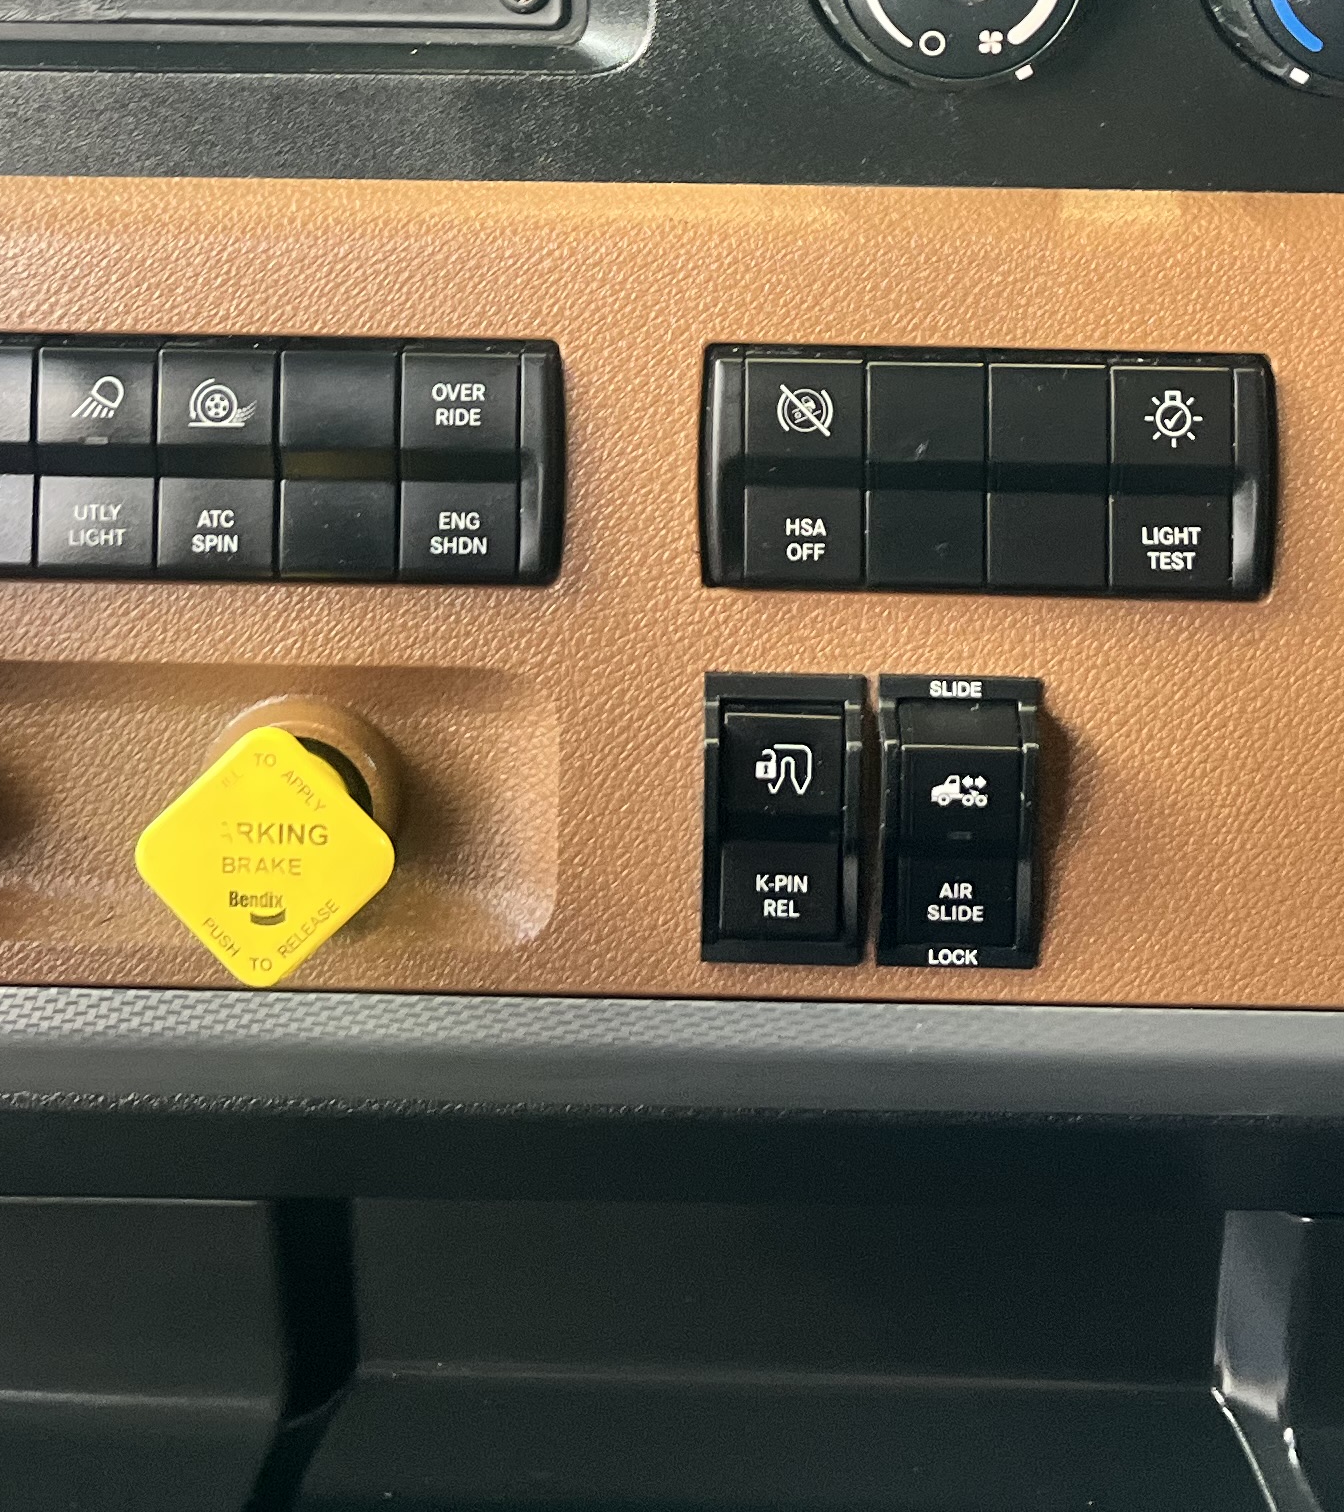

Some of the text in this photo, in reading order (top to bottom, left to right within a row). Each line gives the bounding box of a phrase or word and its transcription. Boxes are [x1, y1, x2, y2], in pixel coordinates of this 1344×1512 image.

[431, 383, 486, 403] OVER
[435, 407, 482, 427] RIDE
[73, 503, 122, 522] UTLY
[196, 509, 235, 529] ATC
[438, 511, 481, 531] ENG
[68, 527, 126, 547] LIGHT
[785, 518, 827, 537] HSA
[1141, 526, 1201, 546] LIGHT
[191, 534, 238, 554] SPIN
[429, 535, 488, 556] SHDN
[786, 542, 826, 562] OFF
[1147, 551, 1196, 571] TEST
[929, 680, 983, 699] SLIDE
[254, 752, 327, 812] TO APPLY
[221, 855, 303, 876] BRAKE
[755, 874, 808, 894] K-PIN
[939, 883, 973, 900] AIR
[228, 890, 284, 908] Bendix
[763, 899, 800, 918] REL
[927, 904, 984, 923] SLIDE
[202, 898, 341, 972] PUSH TO RELEASE
[928, 948, 978, 966] LOCK
